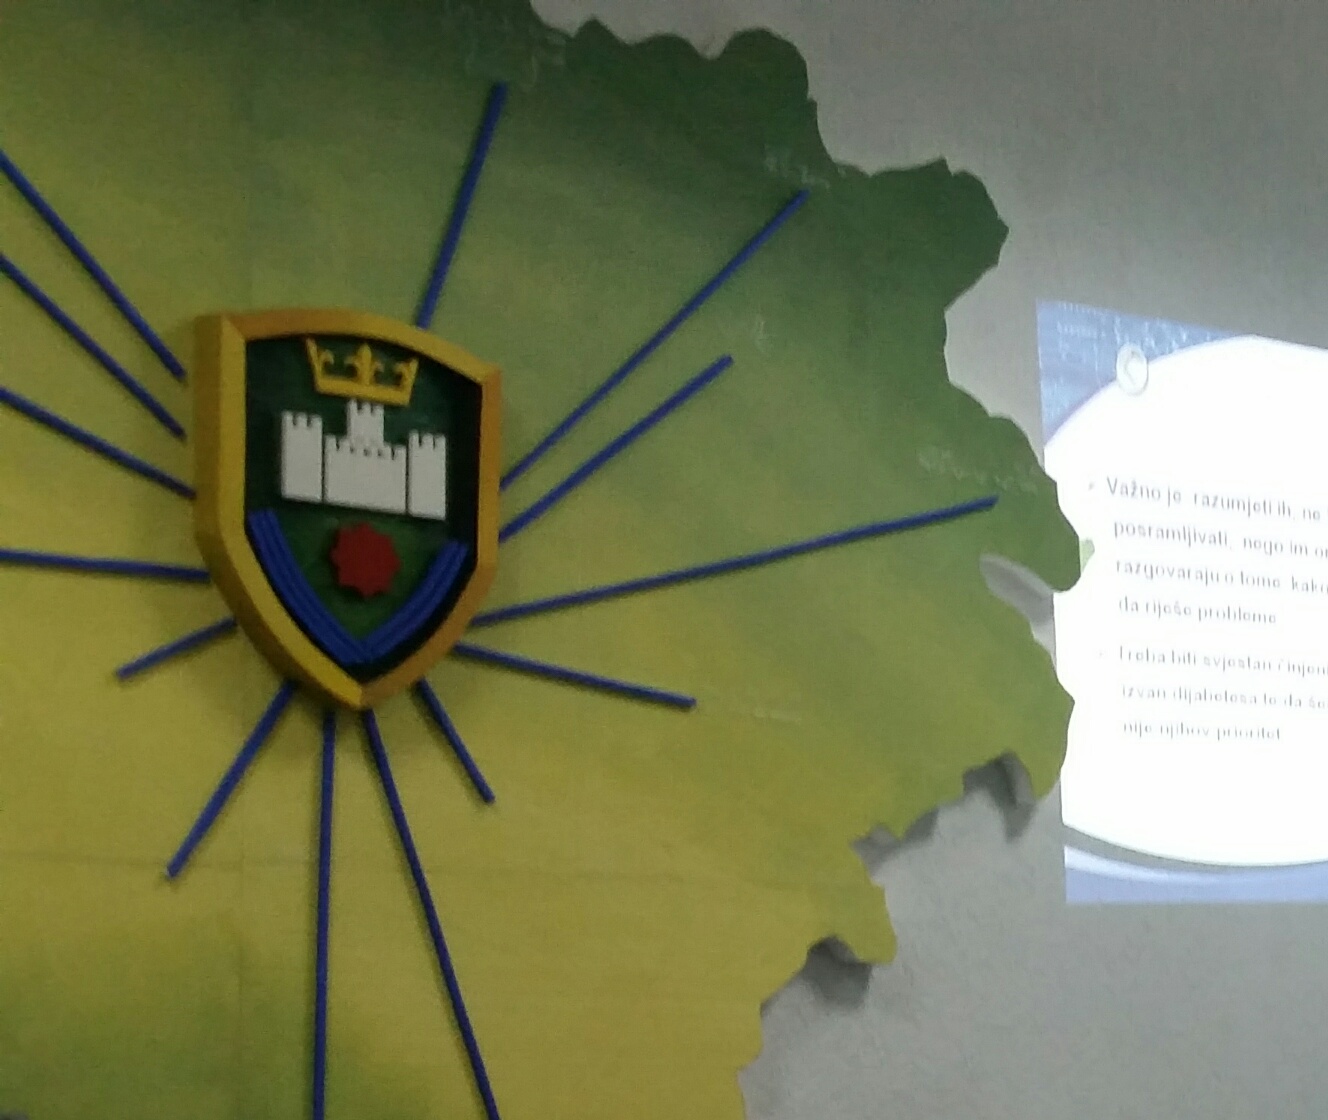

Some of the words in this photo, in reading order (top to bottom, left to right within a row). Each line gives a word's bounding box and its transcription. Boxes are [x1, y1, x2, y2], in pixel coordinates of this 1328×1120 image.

[1106, 476, 1161, 500] Važno
[1167, 486, 1182, 507] je
[1193, 493, 1272, 517] razumjeti
[1302, 507, 1321, 521] ne
[1243, 536, 1283, 556] nego
[1290, 540, 1308, 557] im
[1116, 560, 1220, 587] razgovaraju
[1224, 572, 1234, 585] o
[1118, 596, 1140, 613] da
